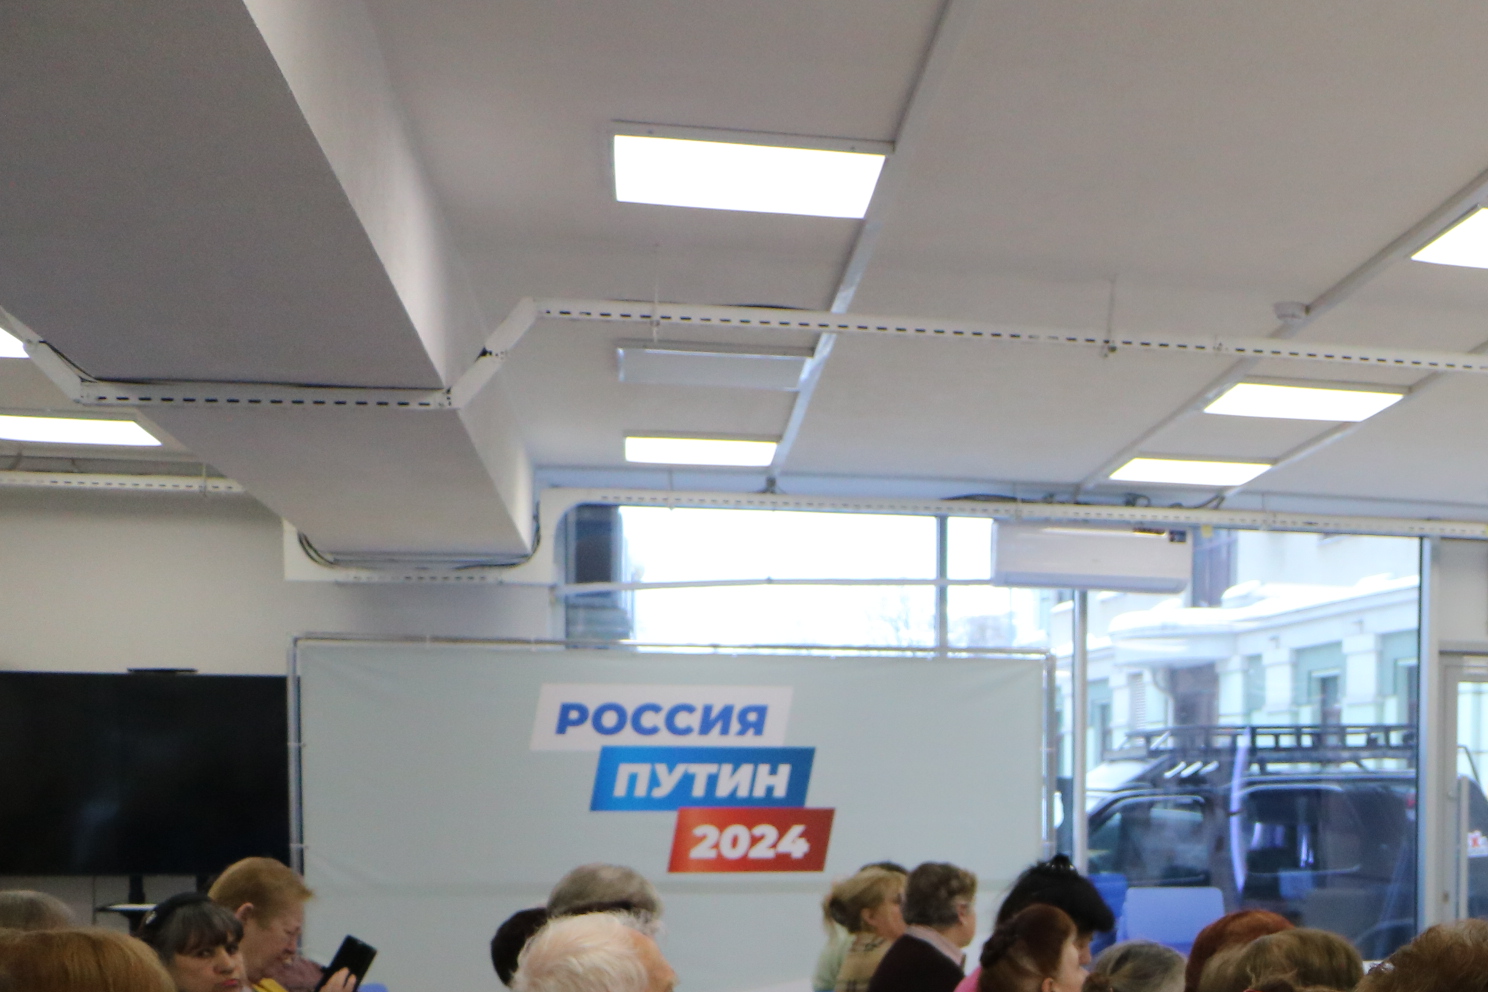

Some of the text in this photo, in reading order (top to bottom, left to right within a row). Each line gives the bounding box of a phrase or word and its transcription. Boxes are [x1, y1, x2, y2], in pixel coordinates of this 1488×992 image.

[555, 702, 769, 736] РОССИЯ
[612, 763, 792, 799] ПУТИН
[688, 823, 811, 860] 2024
